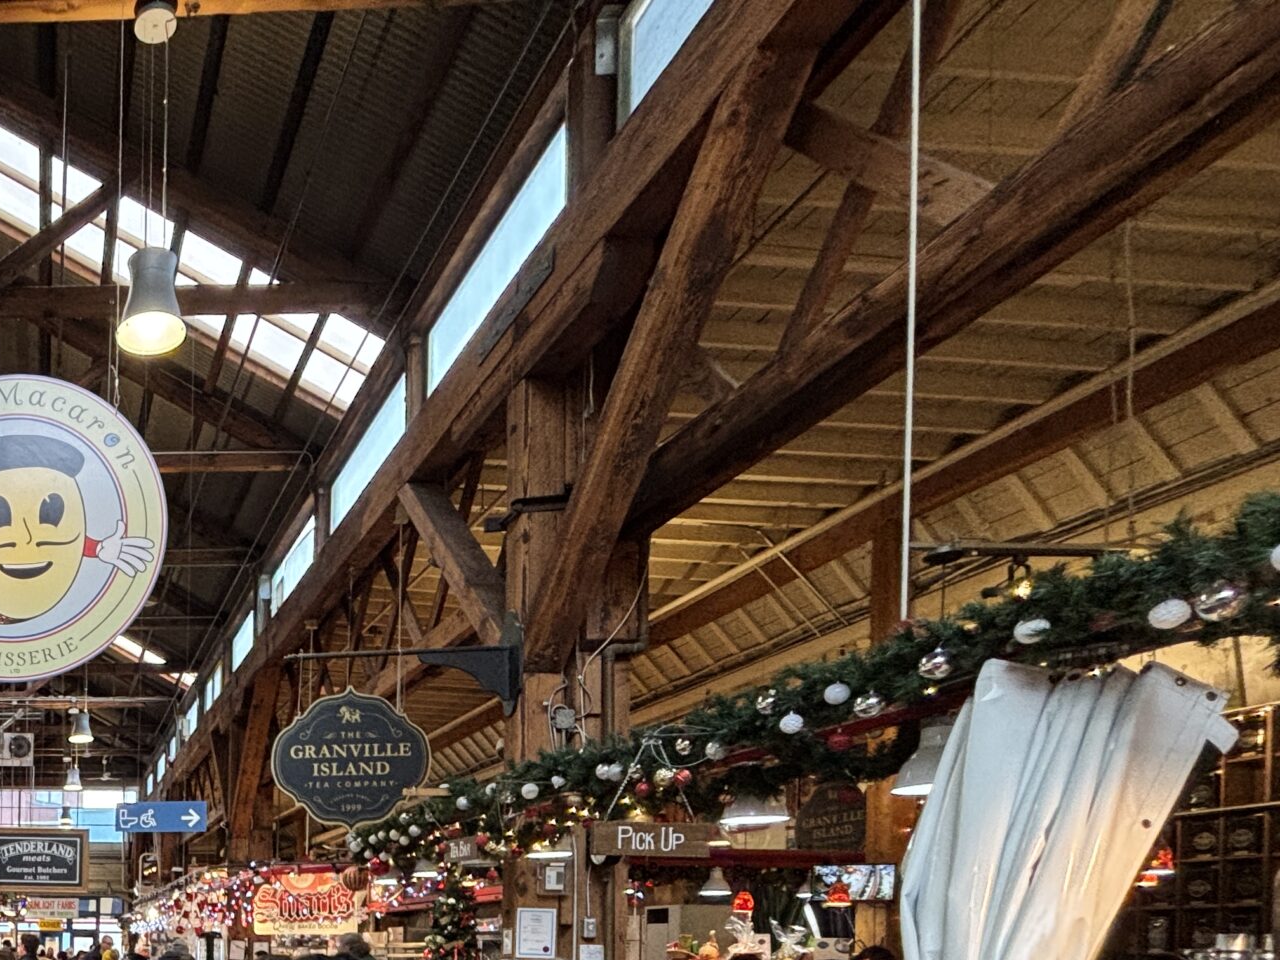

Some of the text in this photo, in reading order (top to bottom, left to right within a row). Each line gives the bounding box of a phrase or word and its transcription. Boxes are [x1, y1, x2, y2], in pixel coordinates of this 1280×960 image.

[340, 731, 362, 739] THE
[289, 742, 412, 760] GRANVILLE
[312, 761, 390, 777] ISLAND
[308, 780, 395, 789] TEA COMPANY
[340, 804, 362, 812] 1999
[1, 841, 74, 858] TENDERLAND
[6, 865, 68, 874] Gourmet Butchers
[254, 884, 354, 923] Stuart's
